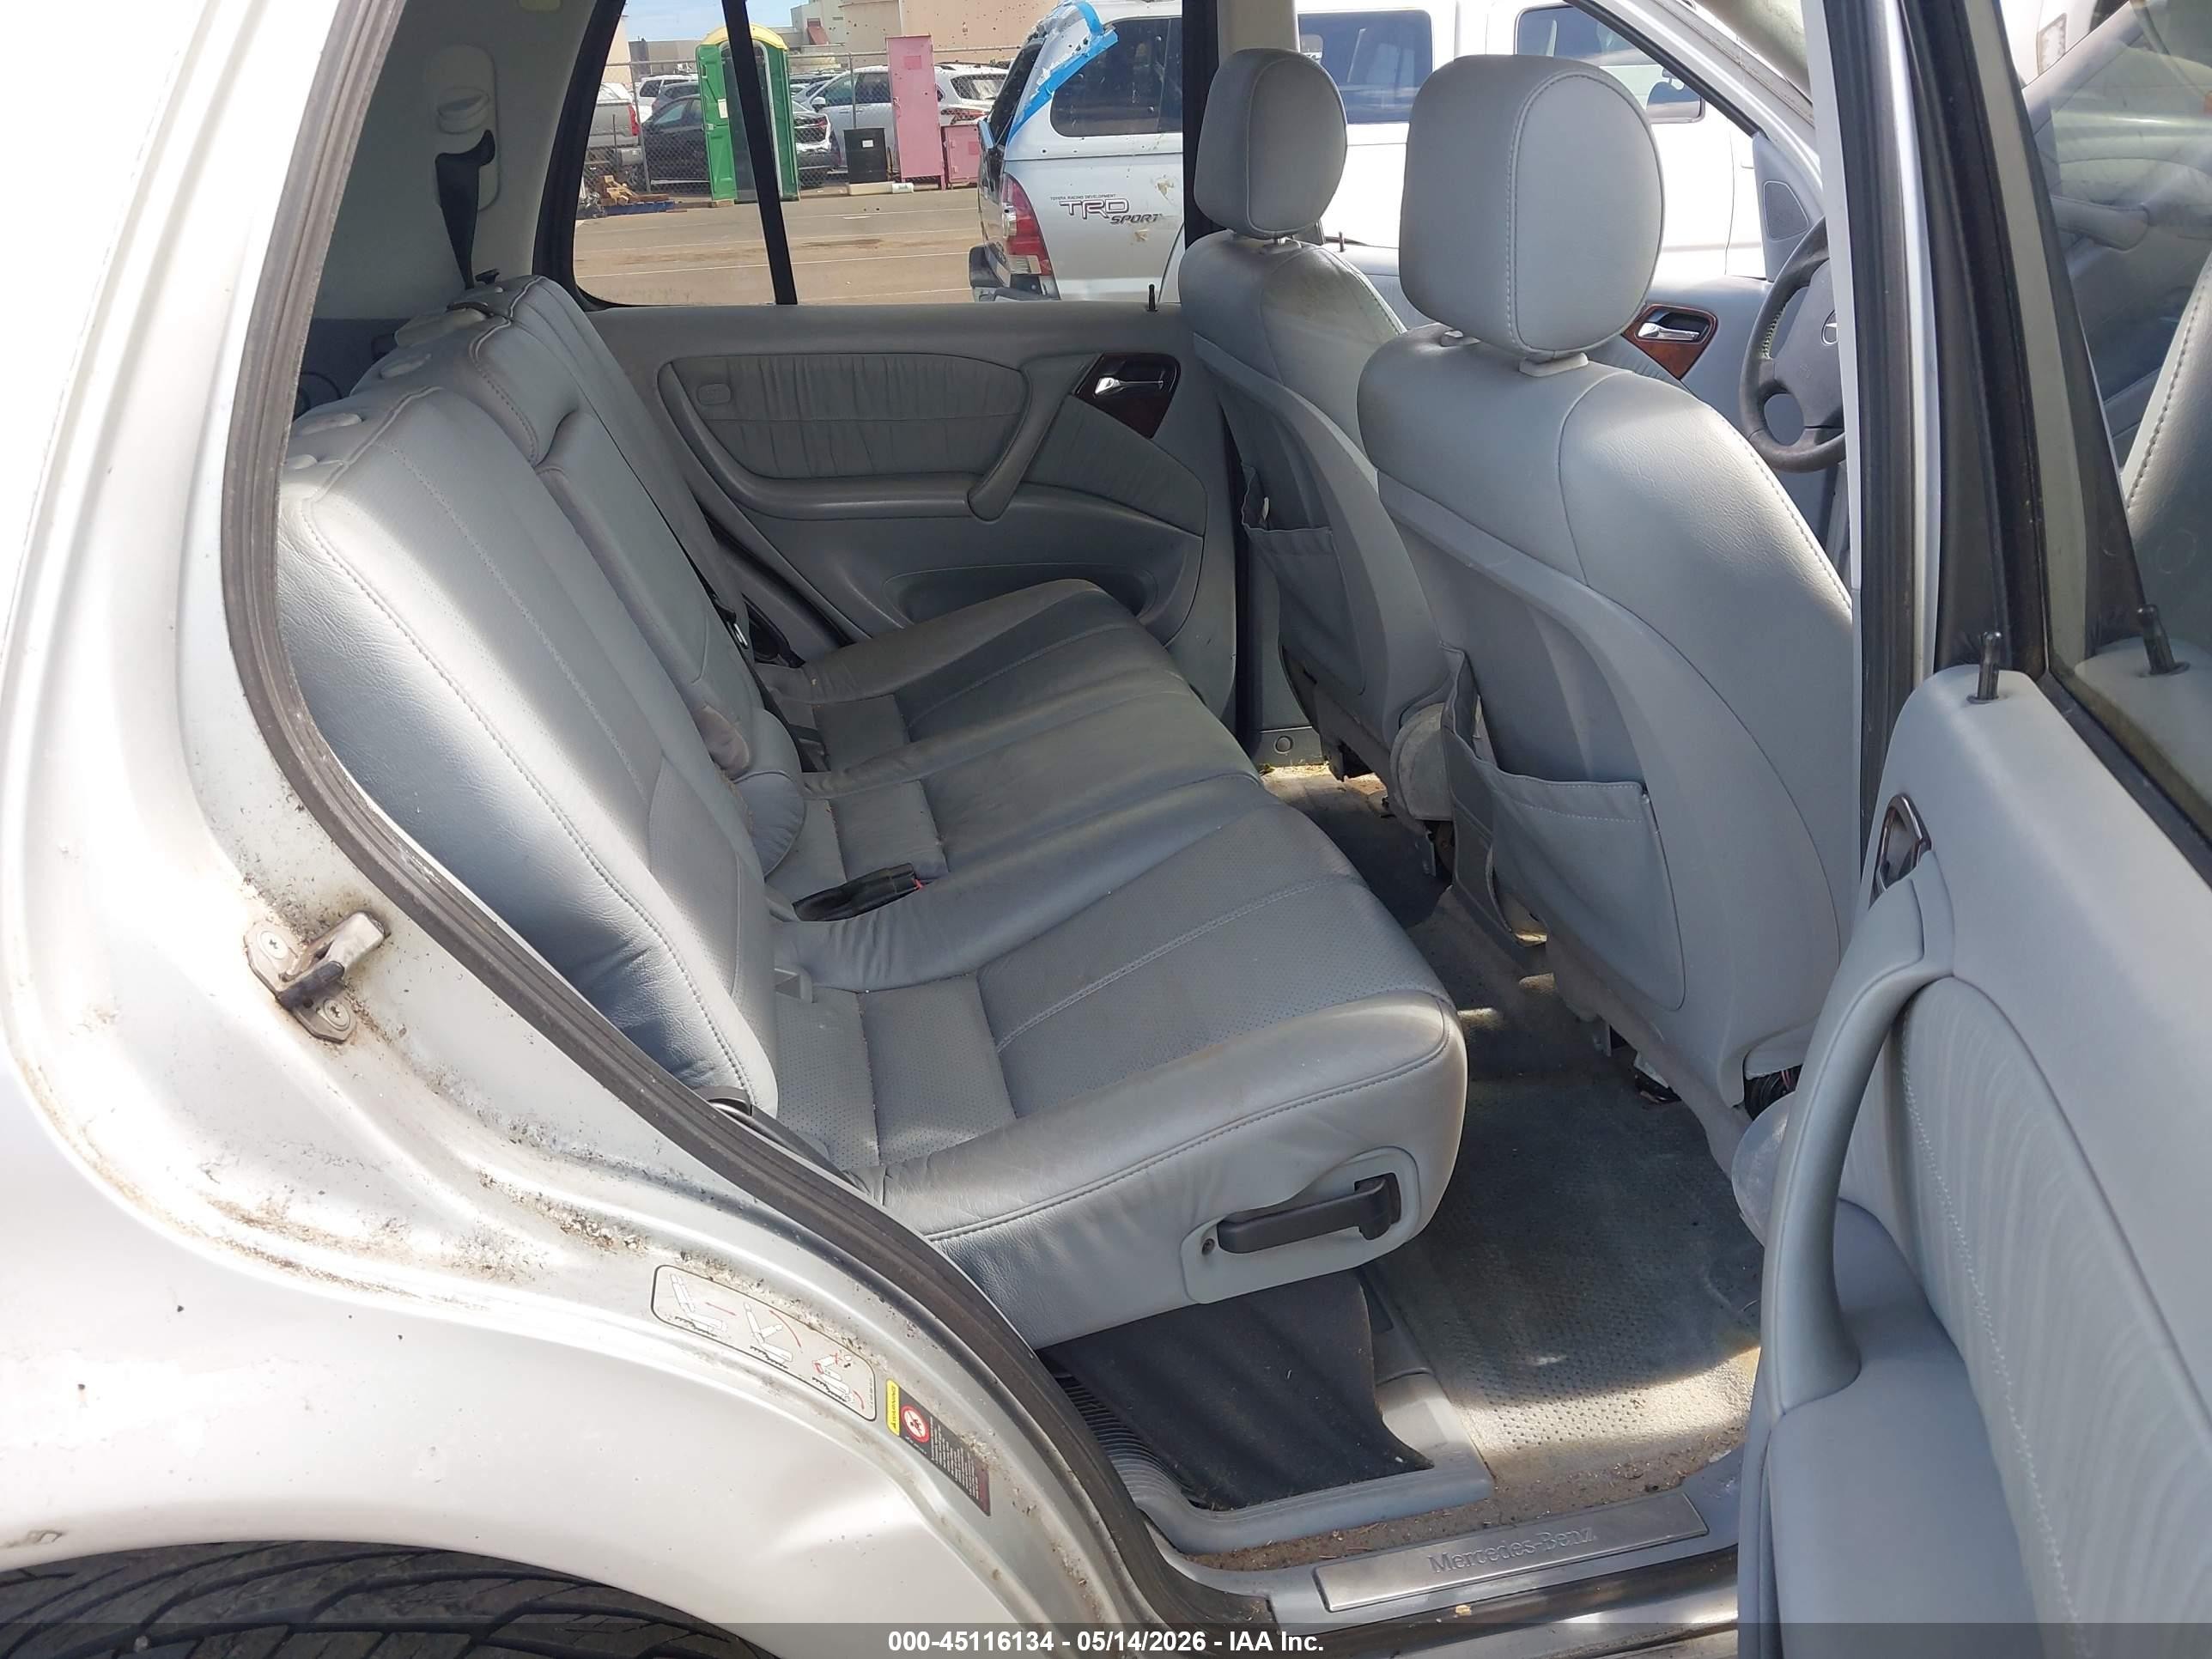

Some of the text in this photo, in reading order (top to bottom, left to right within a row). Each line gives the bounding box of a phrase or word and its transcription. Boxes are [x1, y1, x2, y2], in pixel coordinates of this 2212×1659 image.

[1059, 198, 1129, 220] TRD
[1110, 214, 1160, 224] SPORT
[1428, 1527, 1597, 1573] Mercedes-Benz
